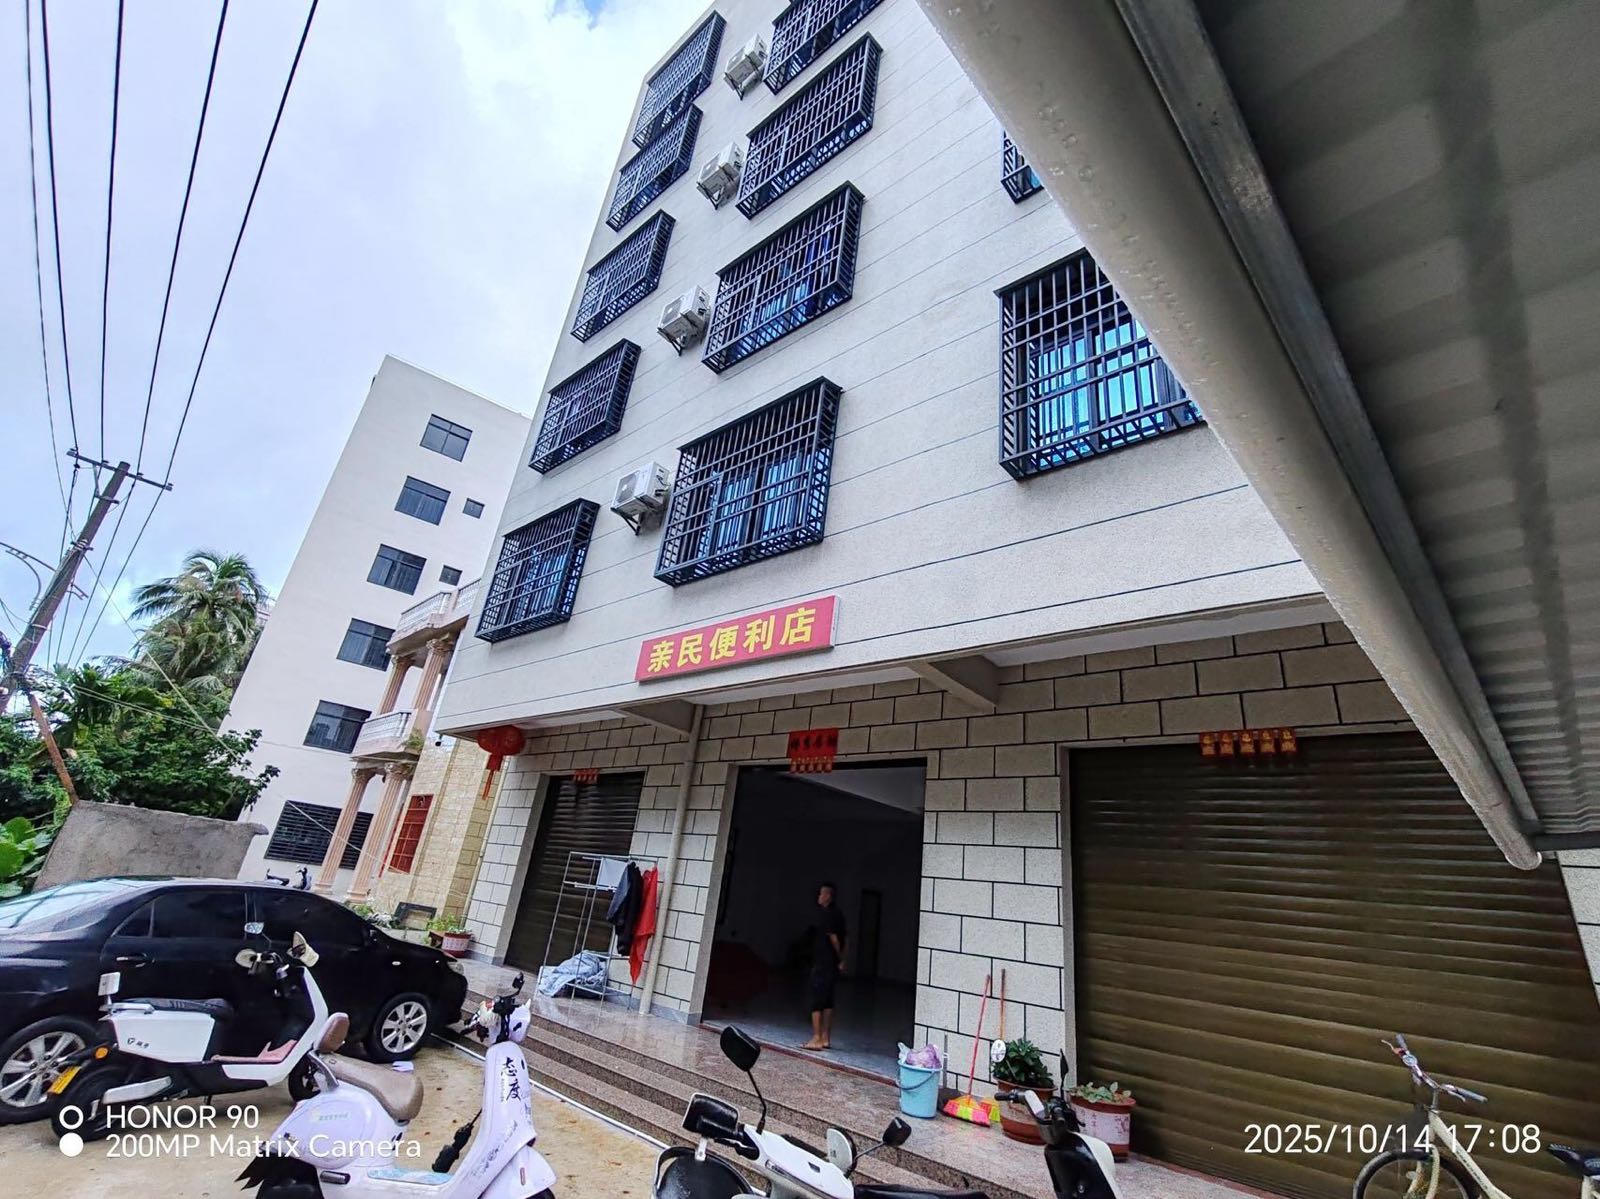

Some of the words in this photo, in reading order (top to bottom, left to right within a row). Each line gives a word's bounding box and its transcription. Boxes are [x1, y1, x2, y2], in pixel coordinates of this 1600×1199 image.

[647, 607, 816, 673] 亲民便利店
[502, 1057, 521, 1101] 态度
